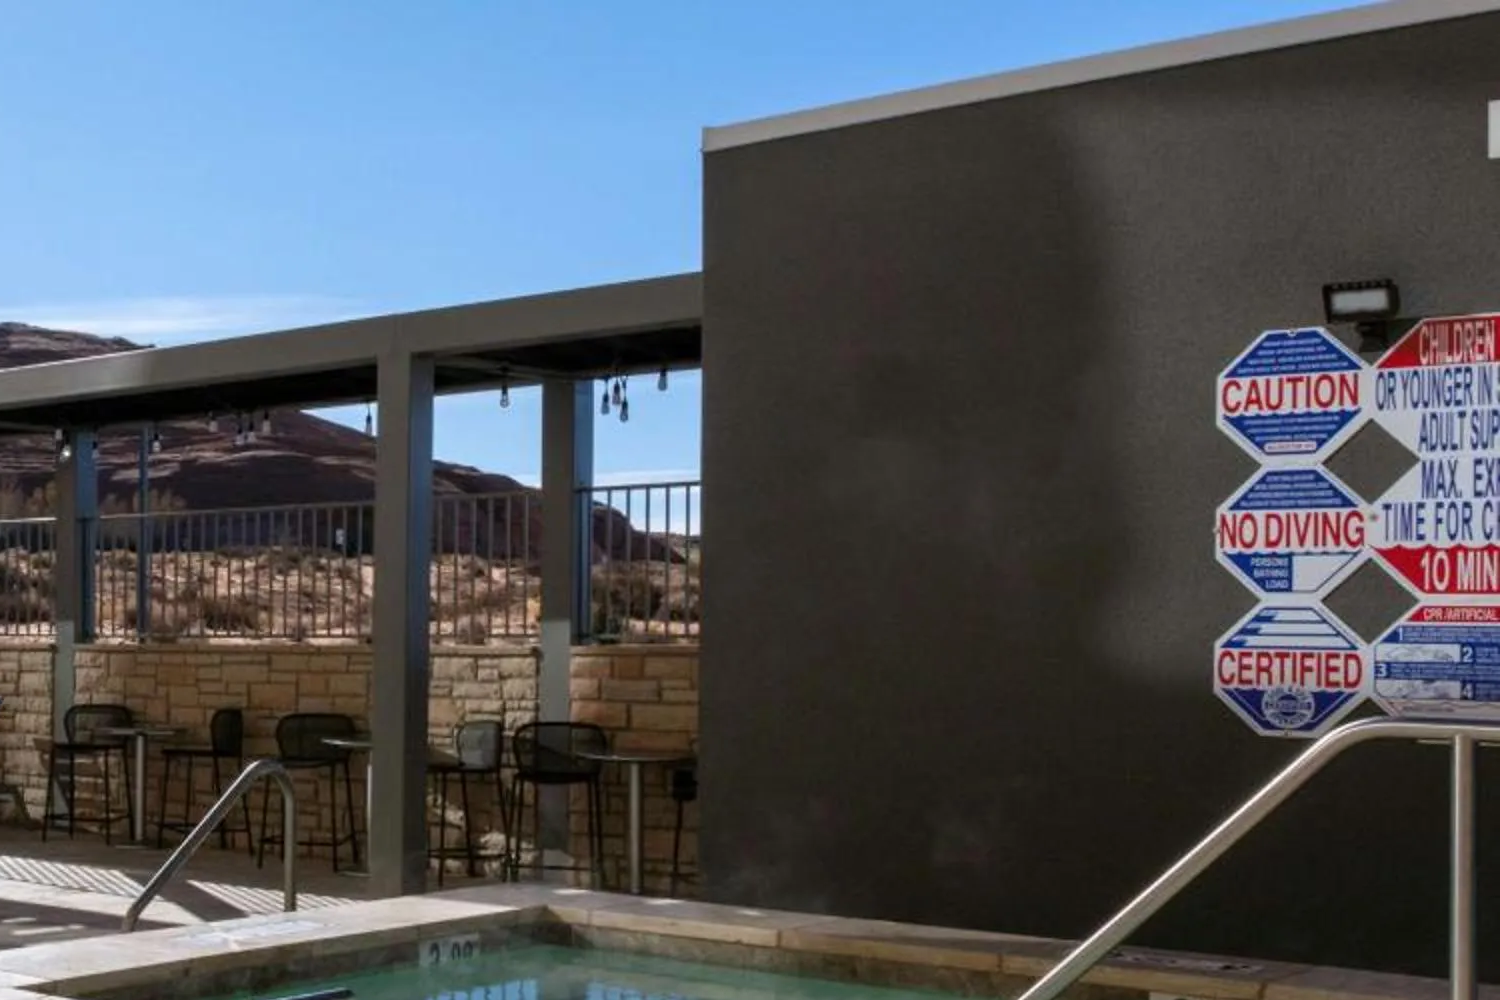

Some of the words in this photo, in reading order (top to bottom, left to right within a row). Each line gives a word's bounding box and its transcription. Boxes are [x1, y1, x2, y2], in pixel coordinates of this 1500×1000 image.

[1420, 319, 1495, 366] CHILDREN
[1222, 373, 1359, 413] CAUTION
[1375, 371, 1396, 411] OR
[1400, 366, 1473, 409] YOUNGER
[1478, 365, 1493, 404] IN
[1418, 410, 1467, 452] ADULT
[1421, 458, 1462, 499] MAX.
[1220, 512, 1258, 549] NO
[1265, 510, 1364, 548] DIVING
[1382, 502, 1426, 541] TIME
[1434, 501, 1473, 541] FOR
[1482, 501, 1500, 540] C
[1421, 550, 1450, 592] 10
[1217, 650, 1362, 688] CERTIFIED
[1376, 663, 1388, 677] 3
[1462, 645, 1474, 662] 2
